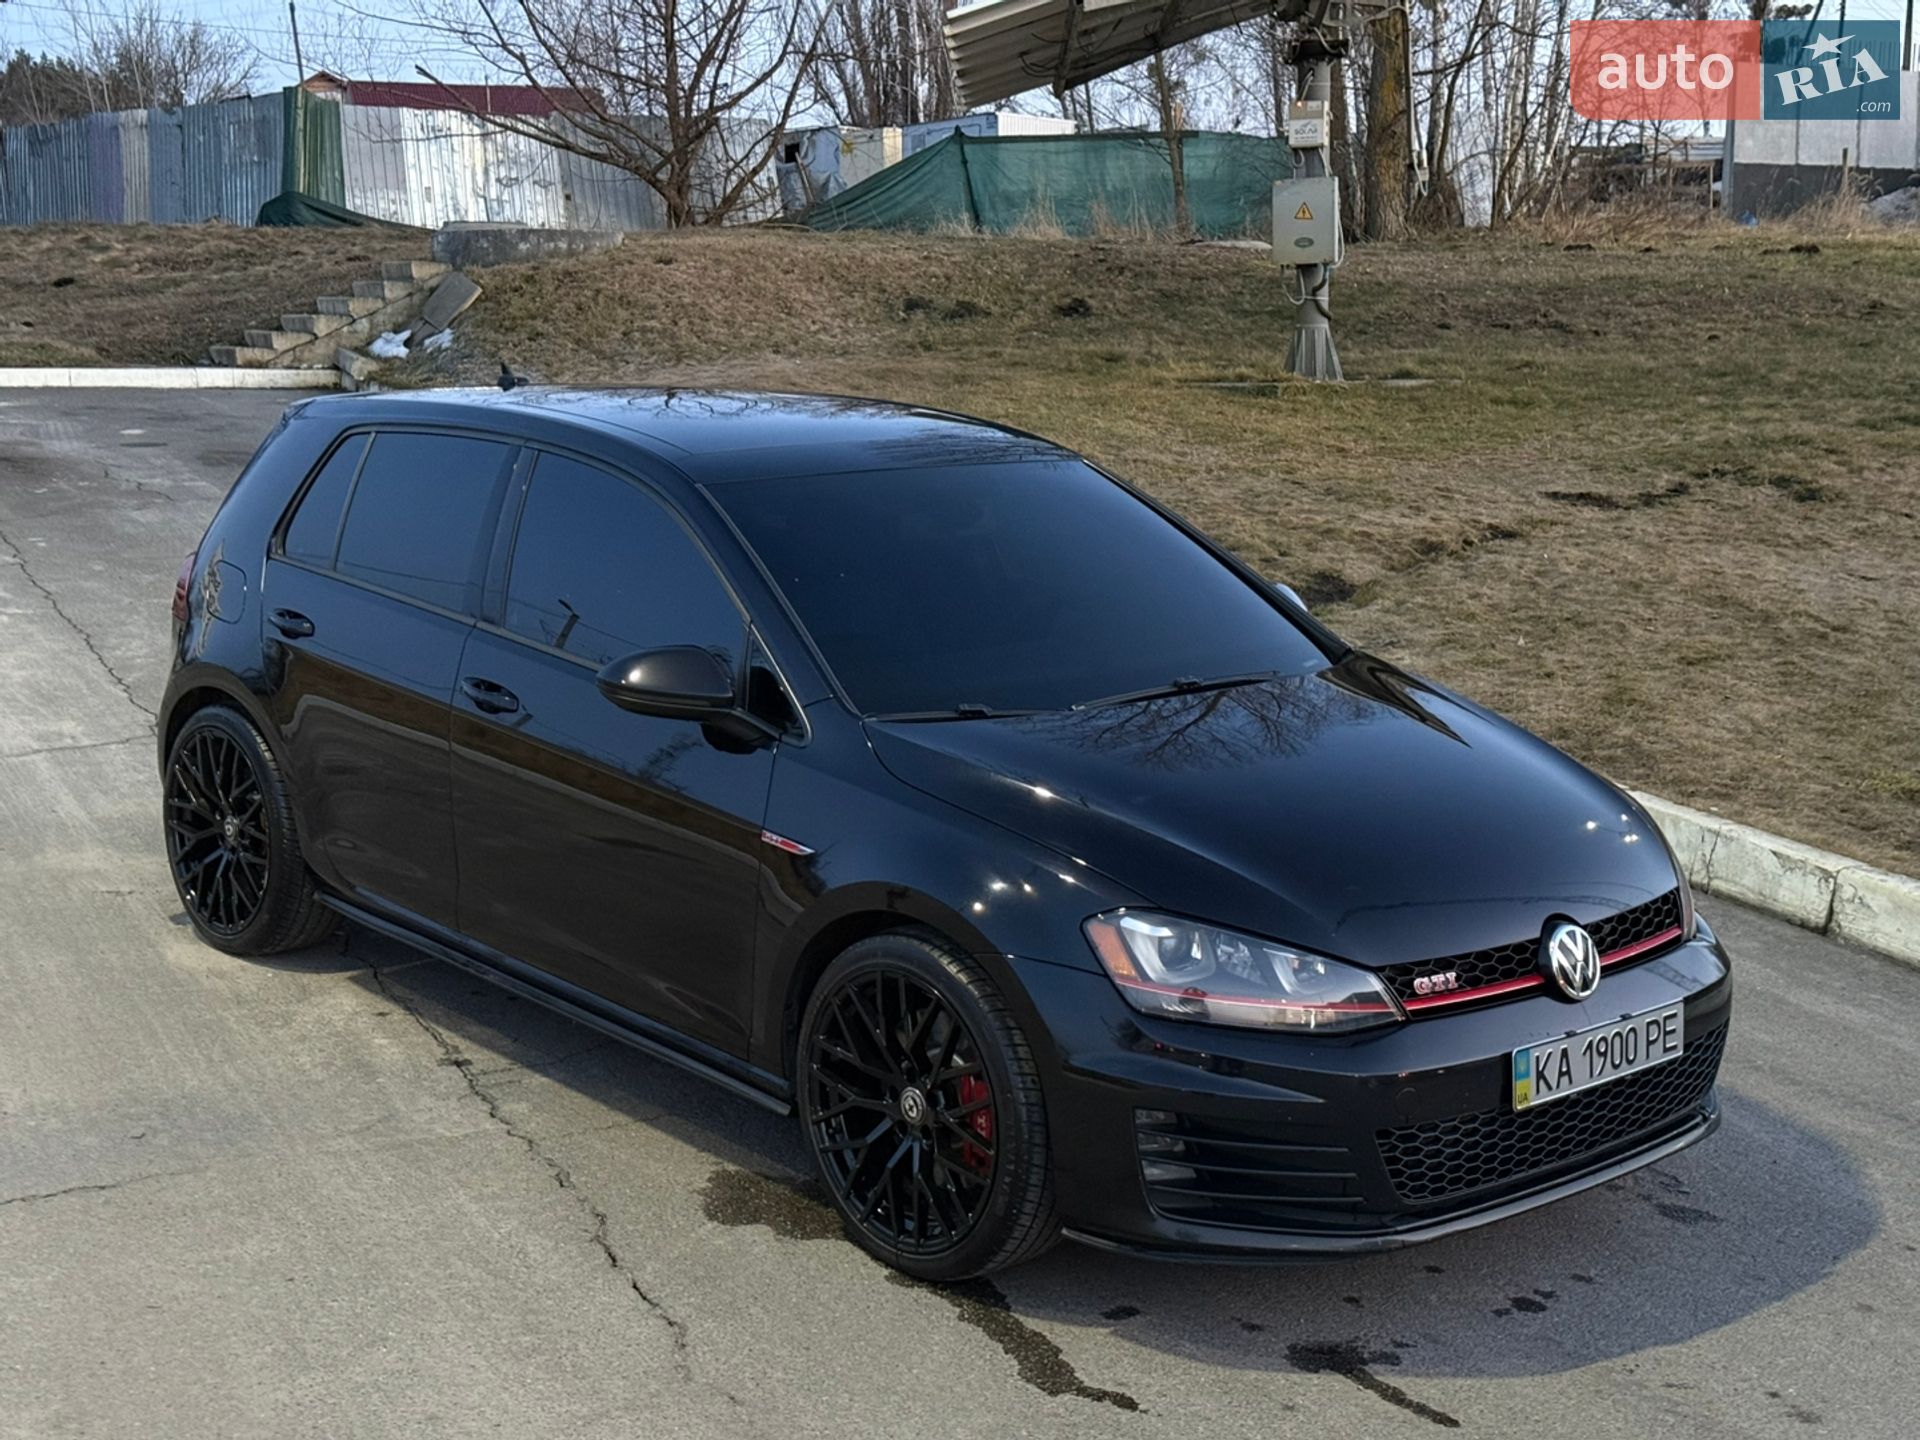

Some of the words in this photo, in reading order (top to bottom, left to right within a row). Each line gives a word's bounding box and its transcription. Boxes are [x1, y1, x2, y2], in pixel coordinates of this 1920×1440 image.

[1413, 971, 1458, 995] GTI
[1534, 1044, 1573, 1095] KA
[1581, 1024, 1638, 1079] 1900
[1645, 1009, 1679, 1061] PE
